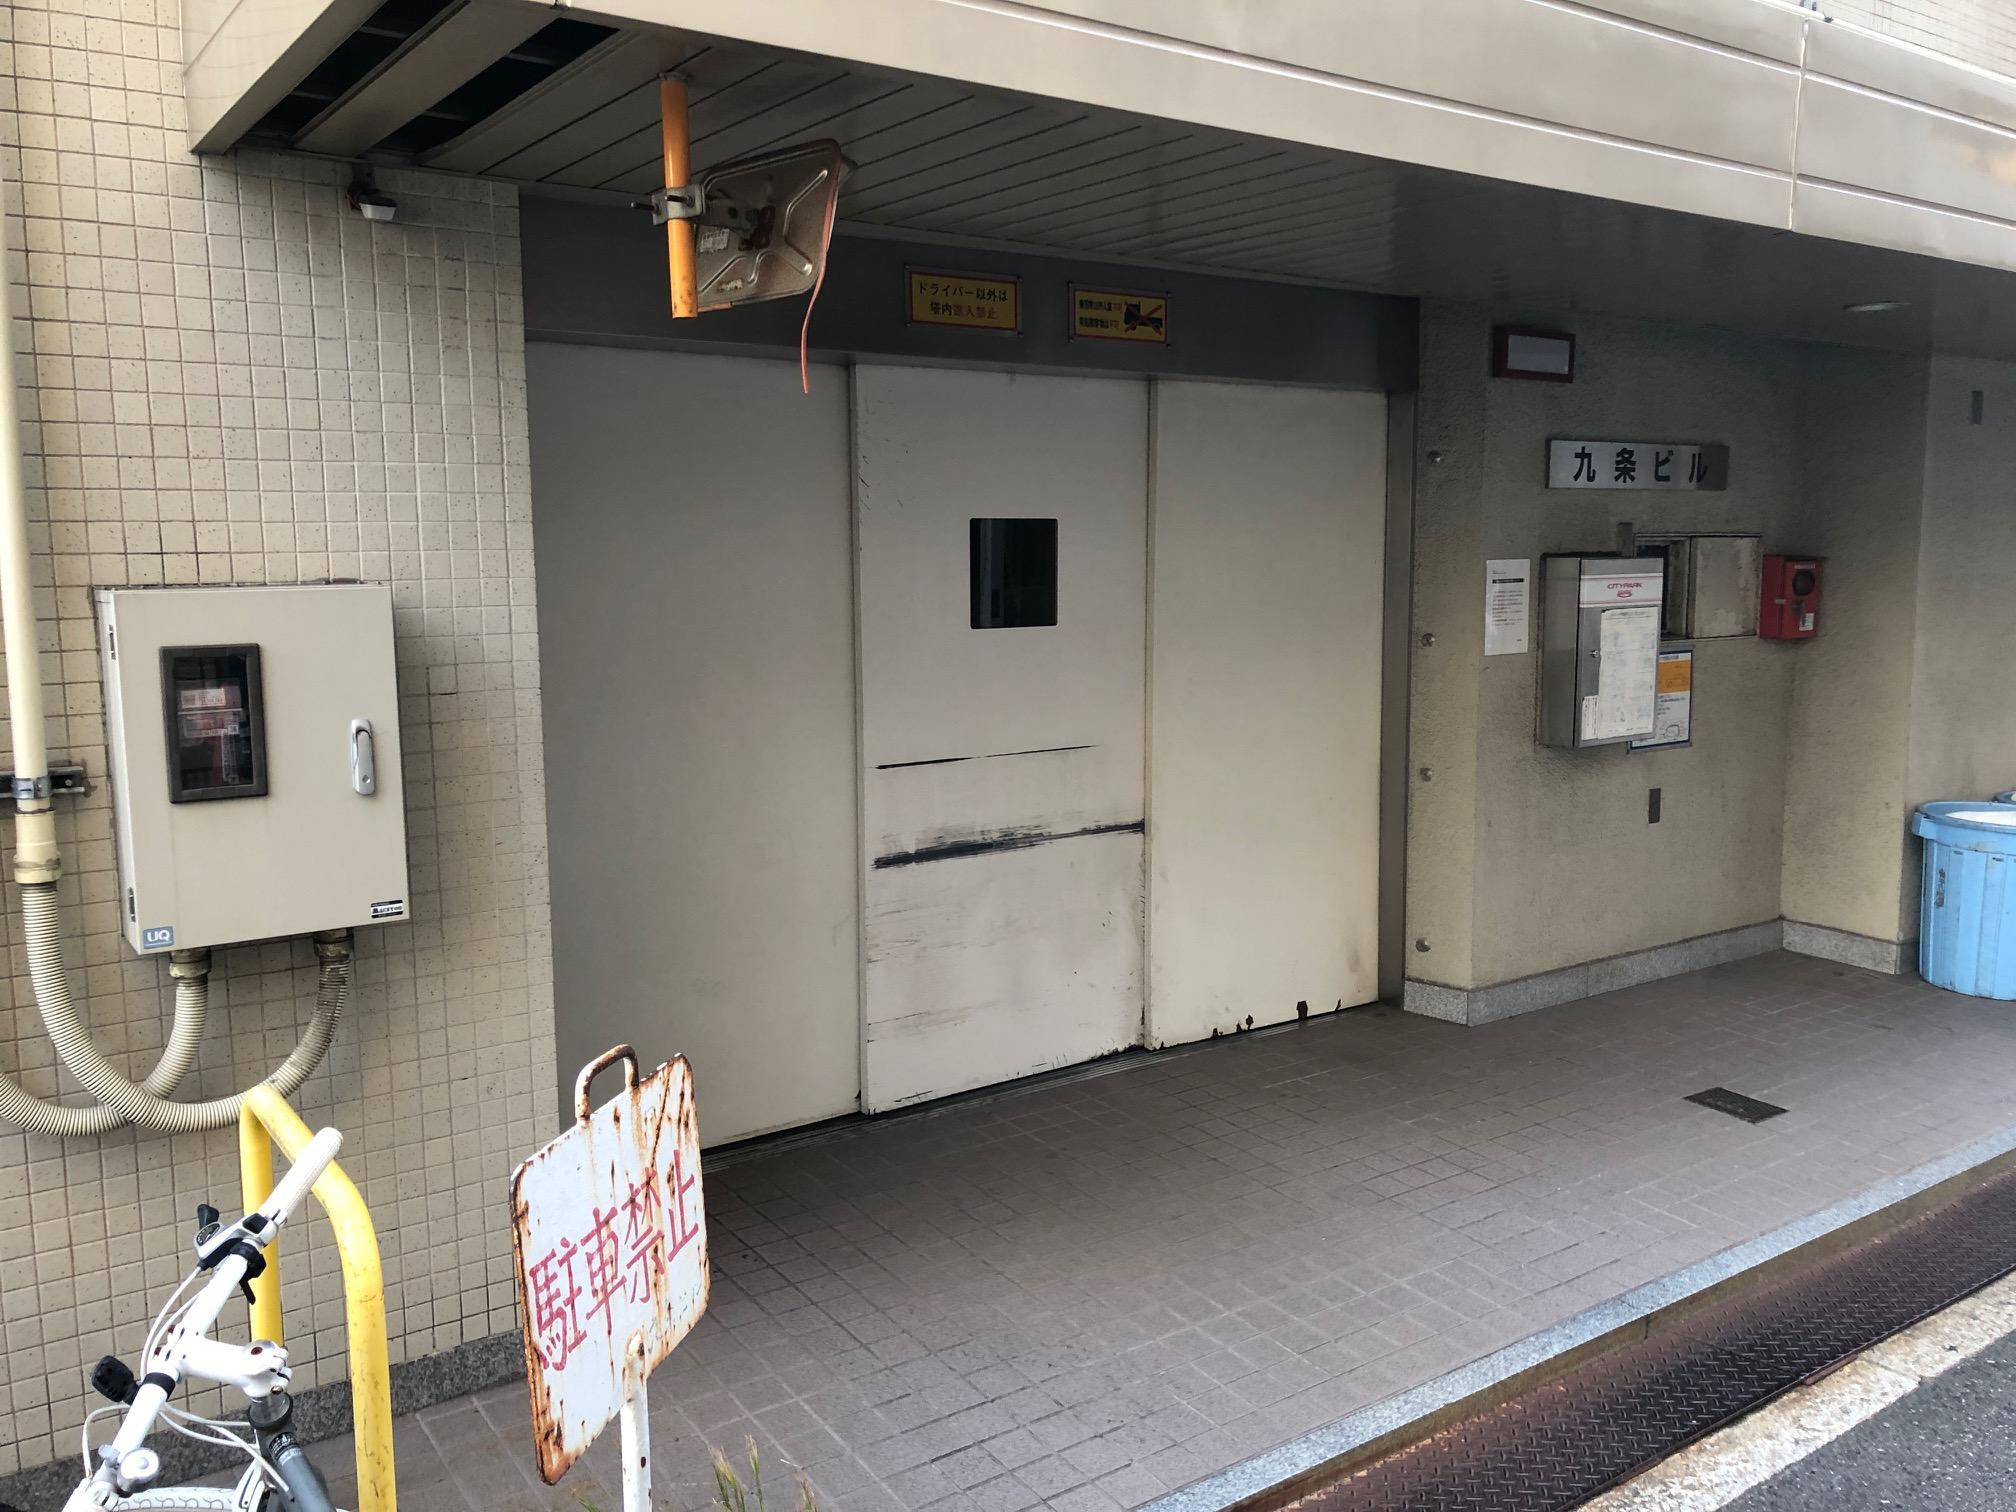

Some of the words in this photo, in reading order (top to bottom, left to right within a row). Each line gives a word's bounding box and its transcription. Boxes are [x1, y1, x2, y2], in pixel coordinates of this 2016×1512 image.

[919, 282, 1008, 302] ドライバー以外は
[1573, 445, 1709, 484] 九条ビル
[147, 929, 171, 942] UQ
[529, 1148, 699, 1371] 駐車禁止
